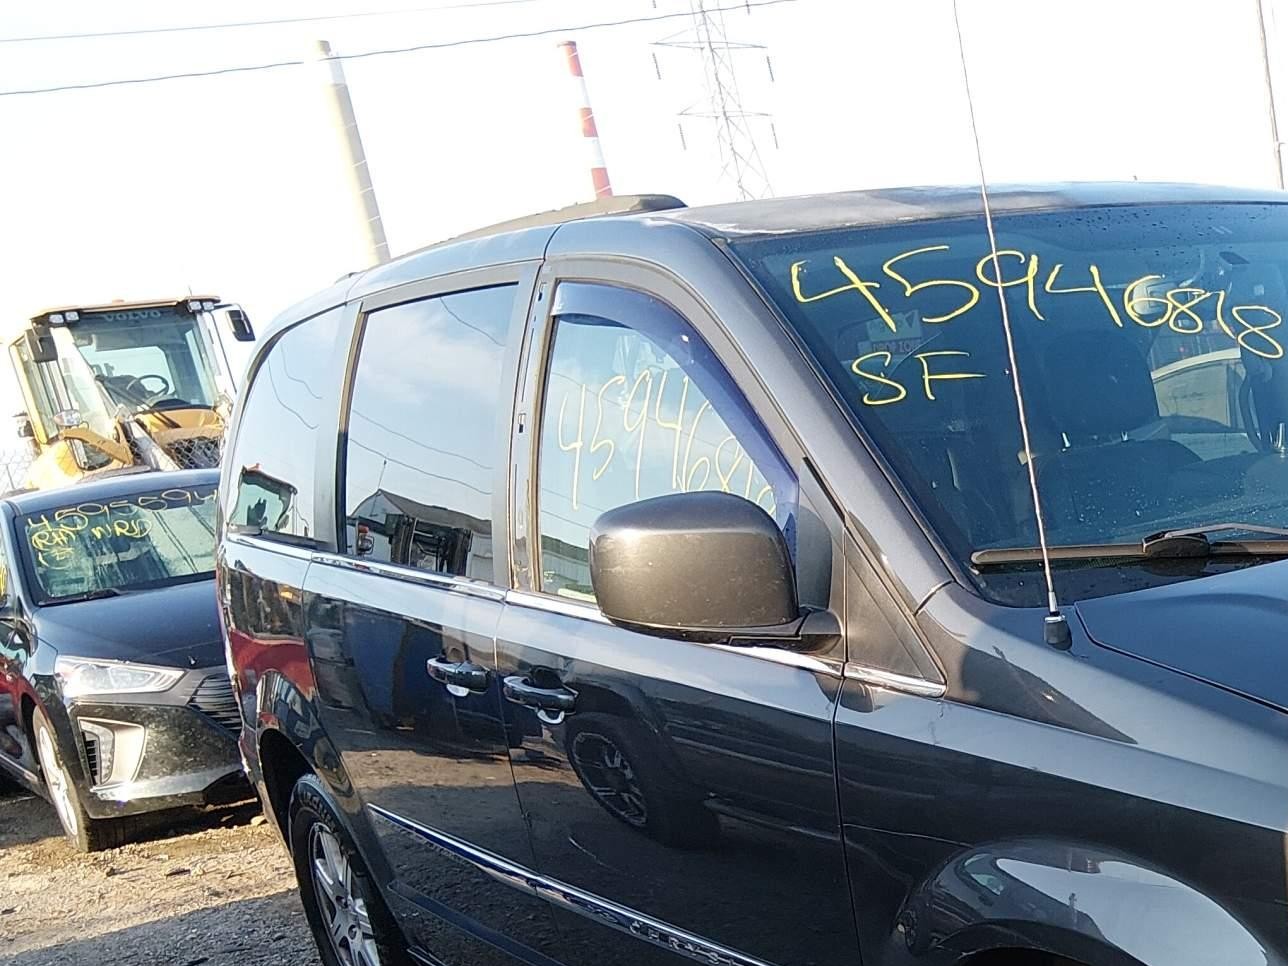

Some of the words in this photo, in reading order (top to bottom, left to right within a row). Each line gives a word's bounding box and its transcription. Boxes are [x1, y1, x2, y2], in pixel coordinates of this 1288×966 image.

[102, 309, 161, 321] VOLVO
[790, 245, 1284, 359] 45946818
[851, 351, 986, 405] SF
